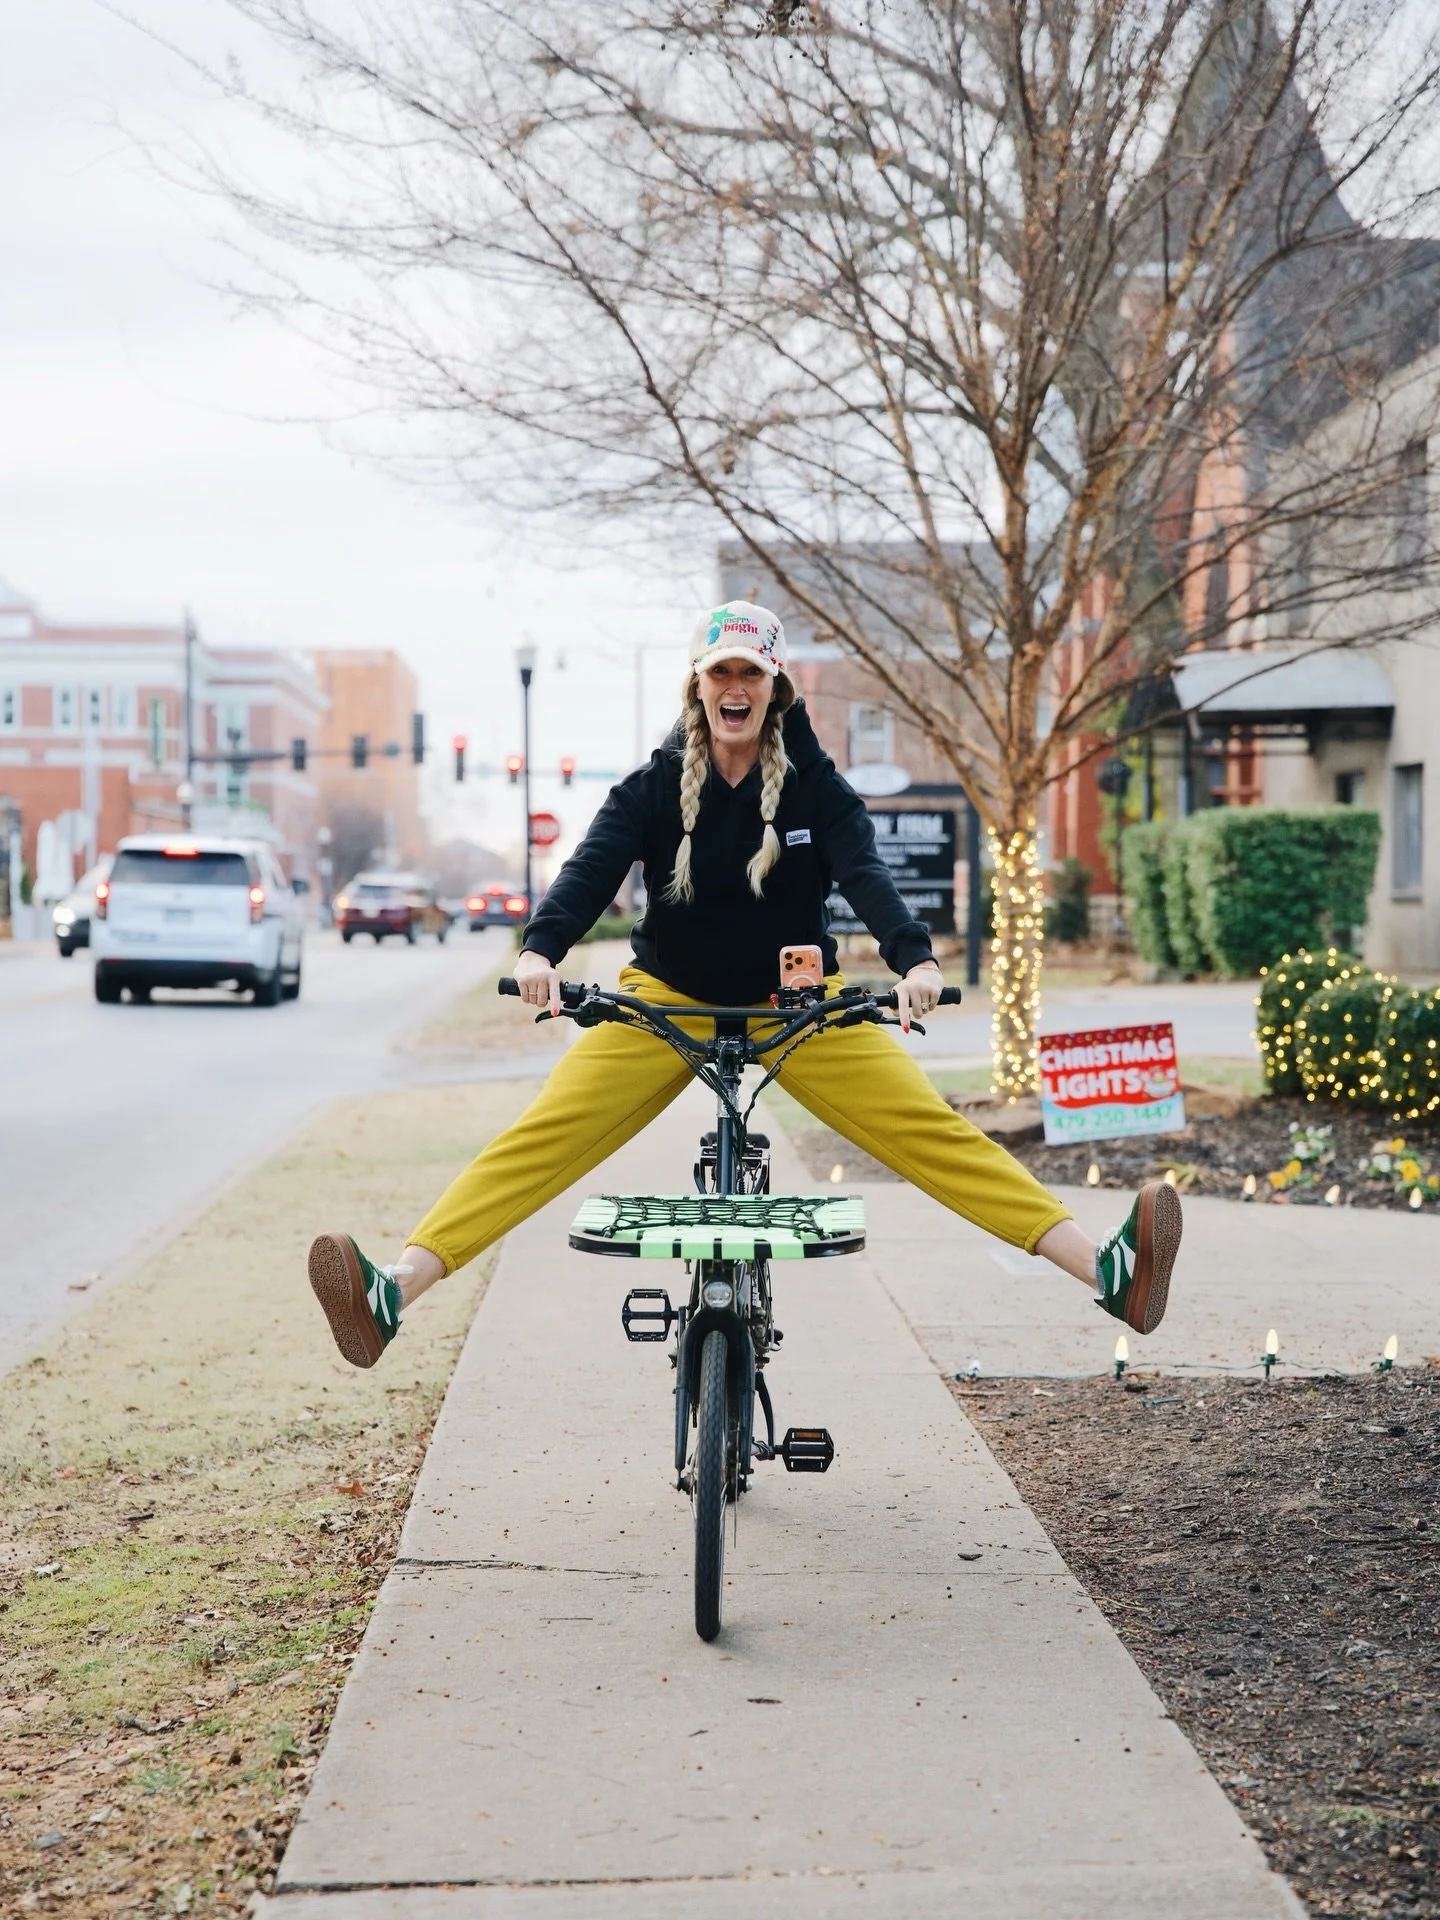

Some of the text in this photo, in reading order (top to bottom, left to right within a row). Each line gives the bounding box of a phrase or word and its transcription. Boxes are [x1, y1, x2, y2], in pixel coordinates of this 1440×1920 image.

[723, 623, 759, 635] bright
[1040, 1037, 1174, 1073] CHRISTMAS
[1042, 1067, 1142, 1102] LIGHTS
